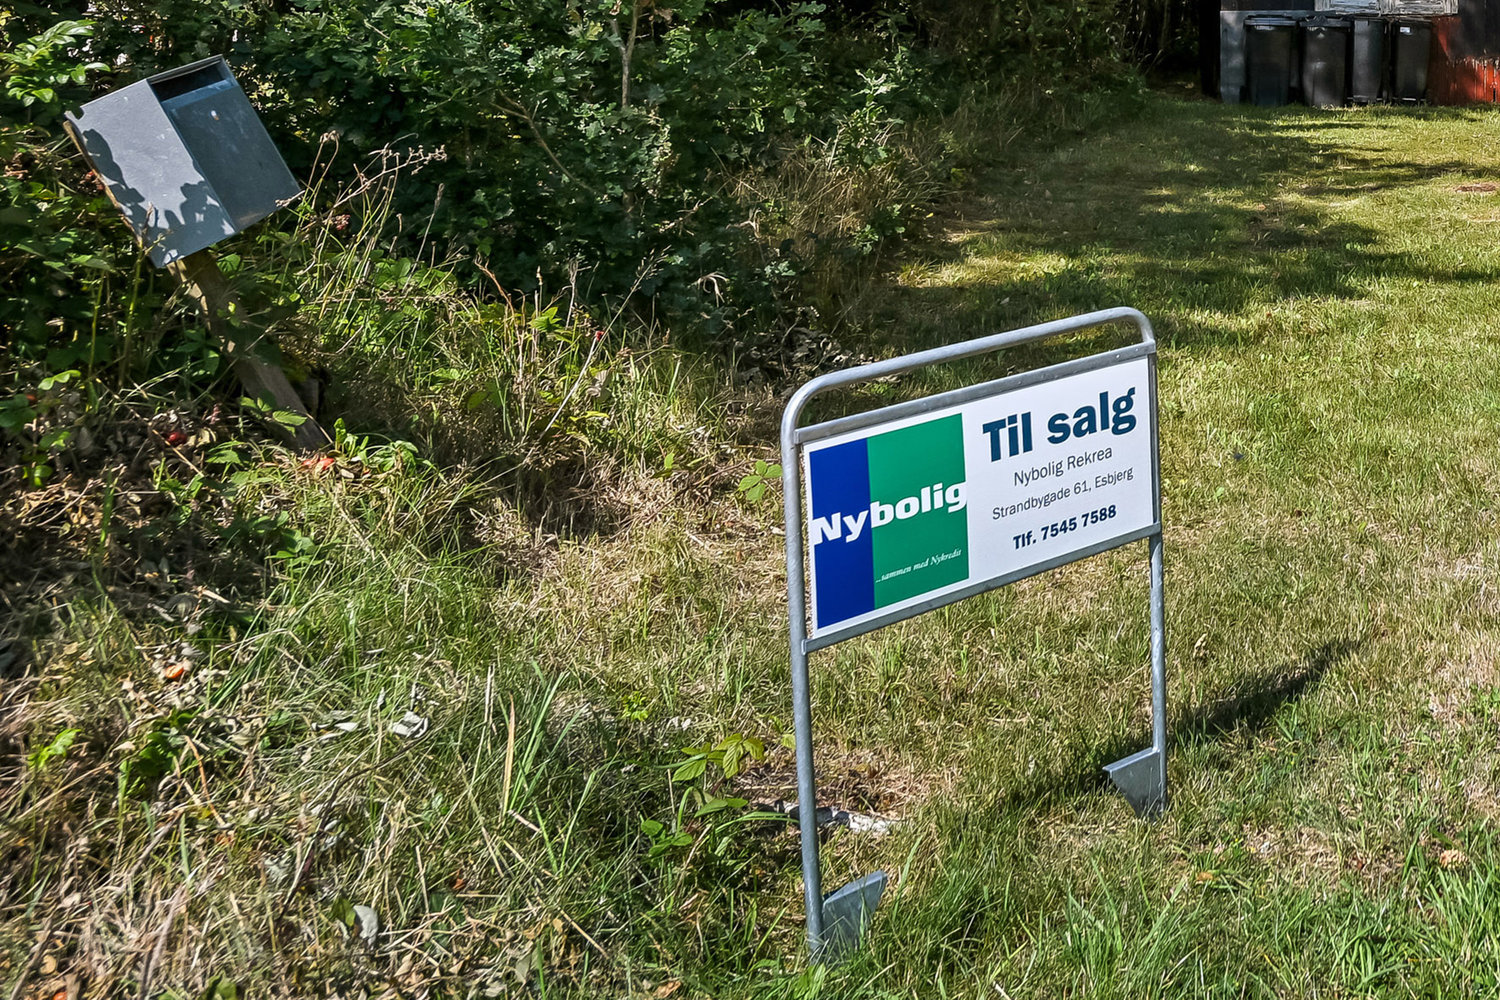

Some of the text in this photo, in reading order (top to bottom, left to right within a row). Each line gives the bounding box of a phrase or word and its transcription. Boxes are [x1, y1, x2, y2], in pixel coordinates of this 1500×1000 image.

[982, 386, 1137, 462] Til salg
[1014, 447, 1112, 486] Nybolig Rekrea
[812, 481, 968, 546] Nybolig
[992, 467, 1134, 520] Strandbygade 61, Esbjerg
[1013, 504, 1117, 550] Tlf. 7545 7588
